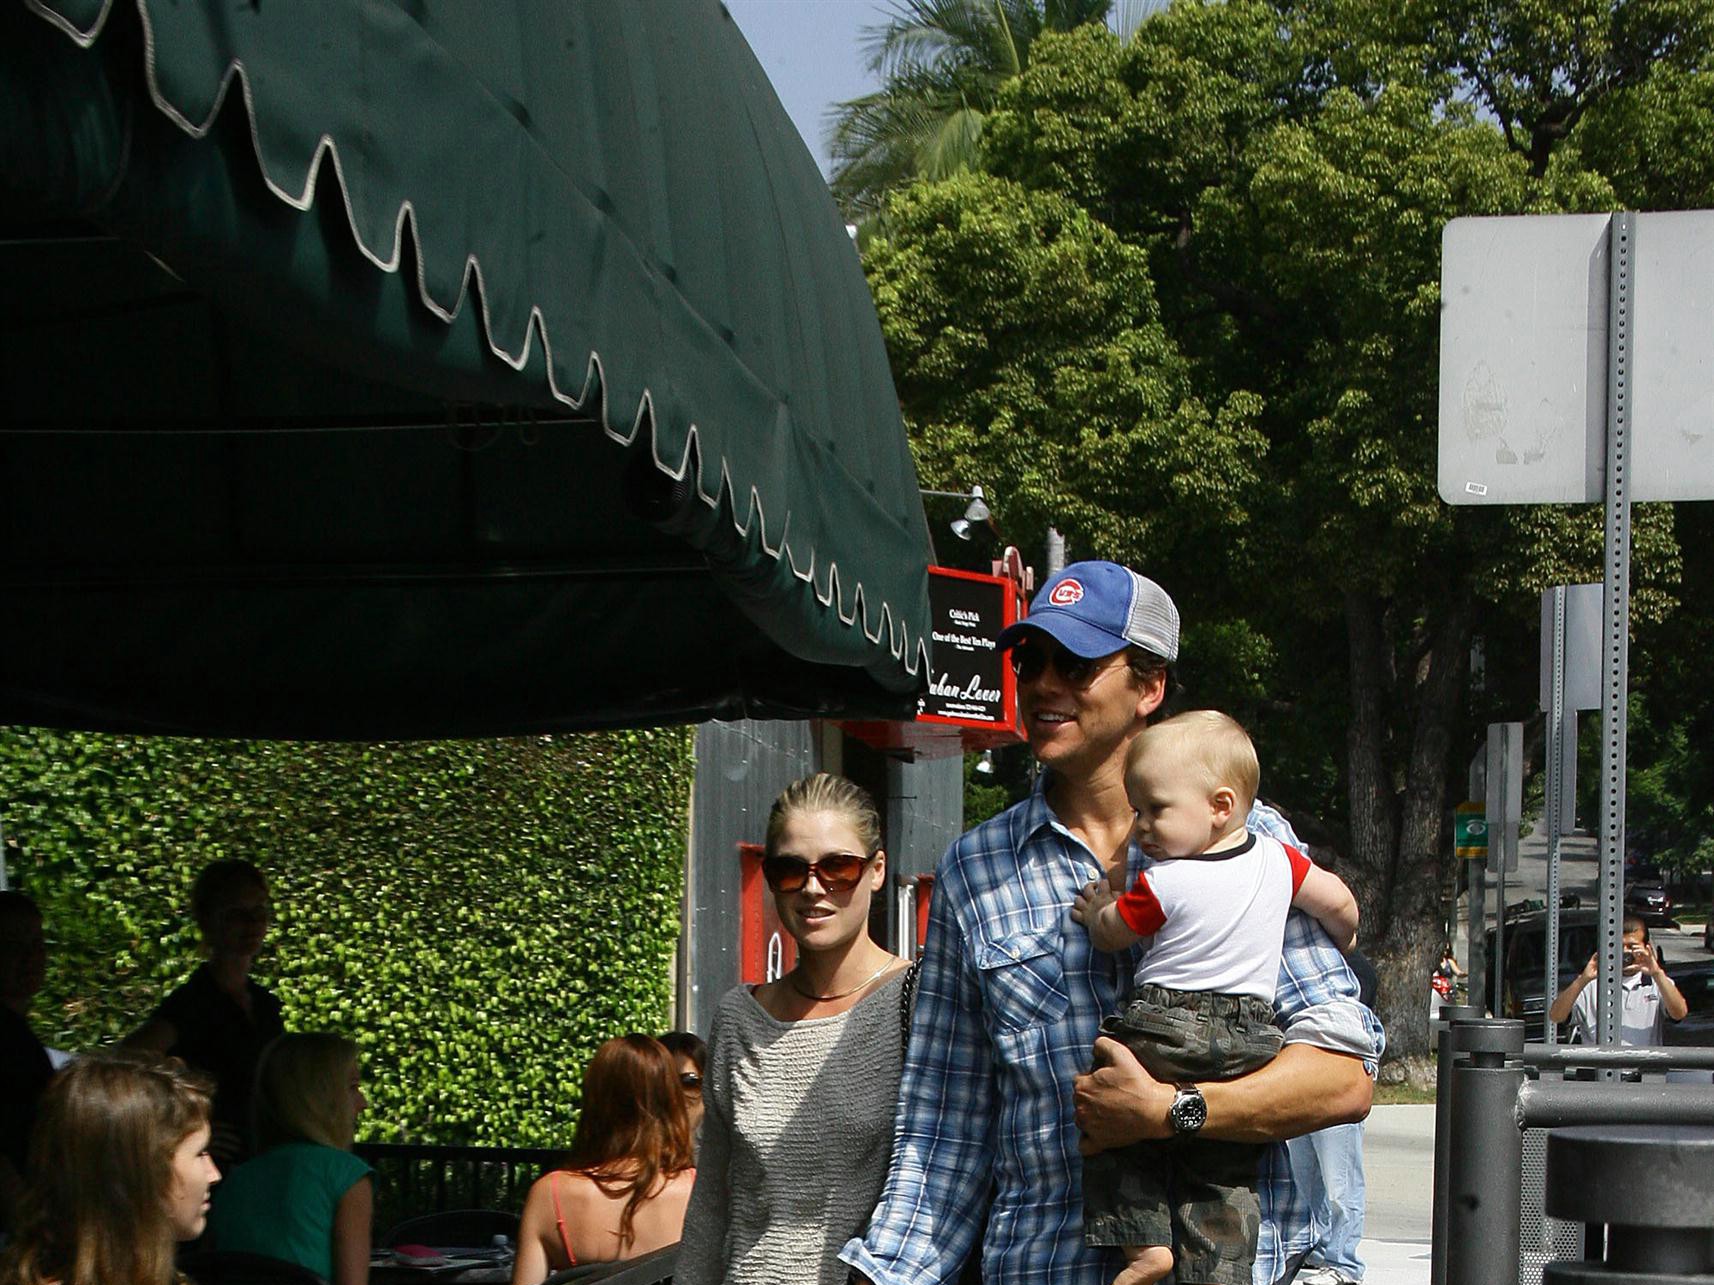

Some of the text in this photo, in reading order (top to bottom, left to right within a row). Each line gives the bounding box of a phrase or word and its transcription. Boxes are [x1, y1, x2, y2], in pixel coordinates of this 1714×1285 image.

[932, 631, 944, 641] One
[944, 633, 951, 642] of
[951, 634, 960, 643] the
[960, 635, 972, 645] Best
